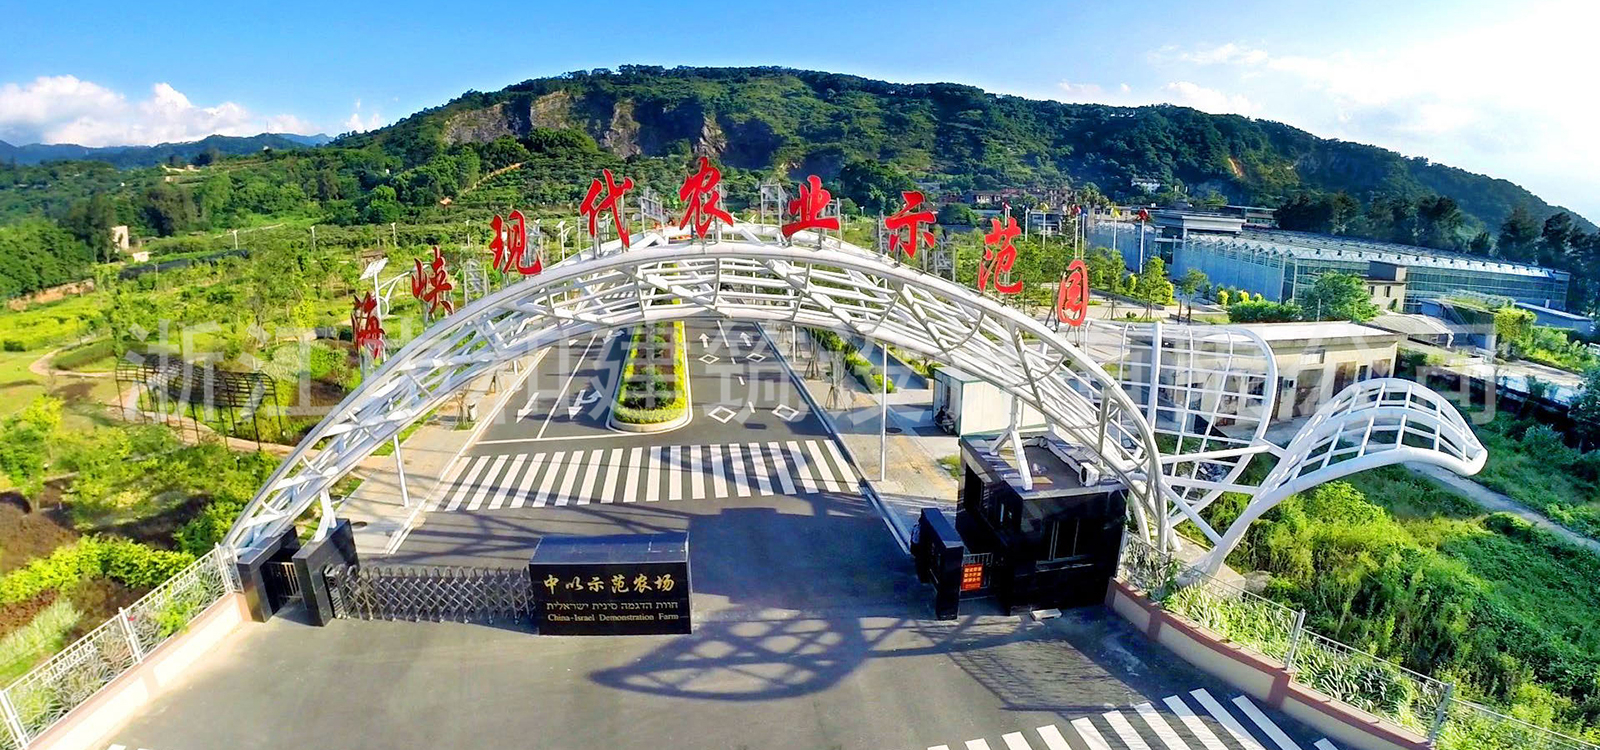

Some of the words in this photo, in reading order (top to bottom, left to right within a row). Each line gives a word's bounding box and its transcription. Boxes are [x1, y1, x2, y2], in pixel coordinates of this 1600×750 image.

[351, 155, 1090, 360] 海峡现代农业示范园
[543, 573, 675, 594] 中以示范农场
[547, 613, 595, 621] China-Israel
[599, 613, 654, 621] Demonstration
